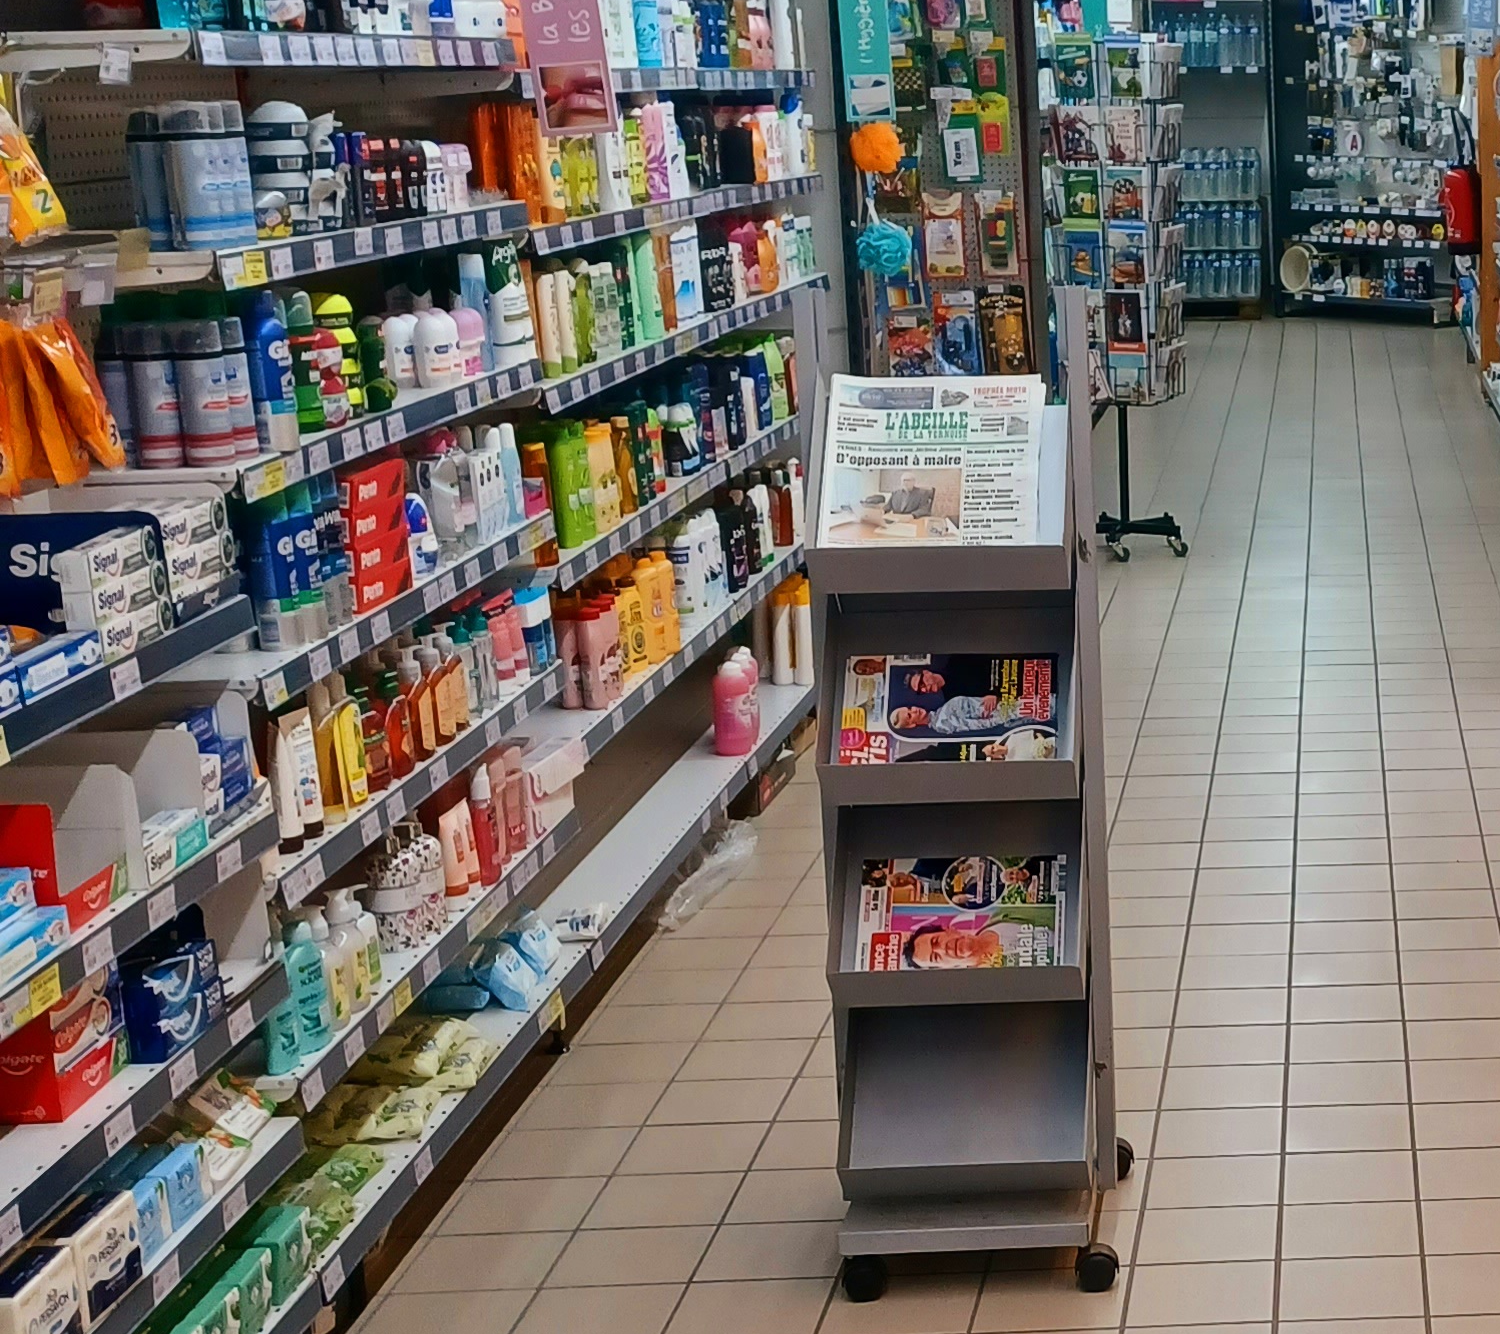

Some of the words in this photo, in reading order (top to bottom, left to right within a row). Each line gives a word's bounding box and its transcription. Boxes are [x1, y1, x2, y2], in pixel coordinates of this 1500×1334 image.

[538, 24, 558, 45] la
[568, 14, 591, 43] les
[885, 410, 969, 432] L'ABEILLE
[836, 452, 909, 468] D'opposant
[911, 453, 921, 466] à
[924, 453, 962, 466] maire
[161, 517, 188, 542] Signal
[92, 547, 119, 574] Signal
[171, 551, 198, 576] Signal
[98, 584, 126, 611] Signal
[106, 620, 134, 649] Signal
[149, 848, 173, 871] Signal
